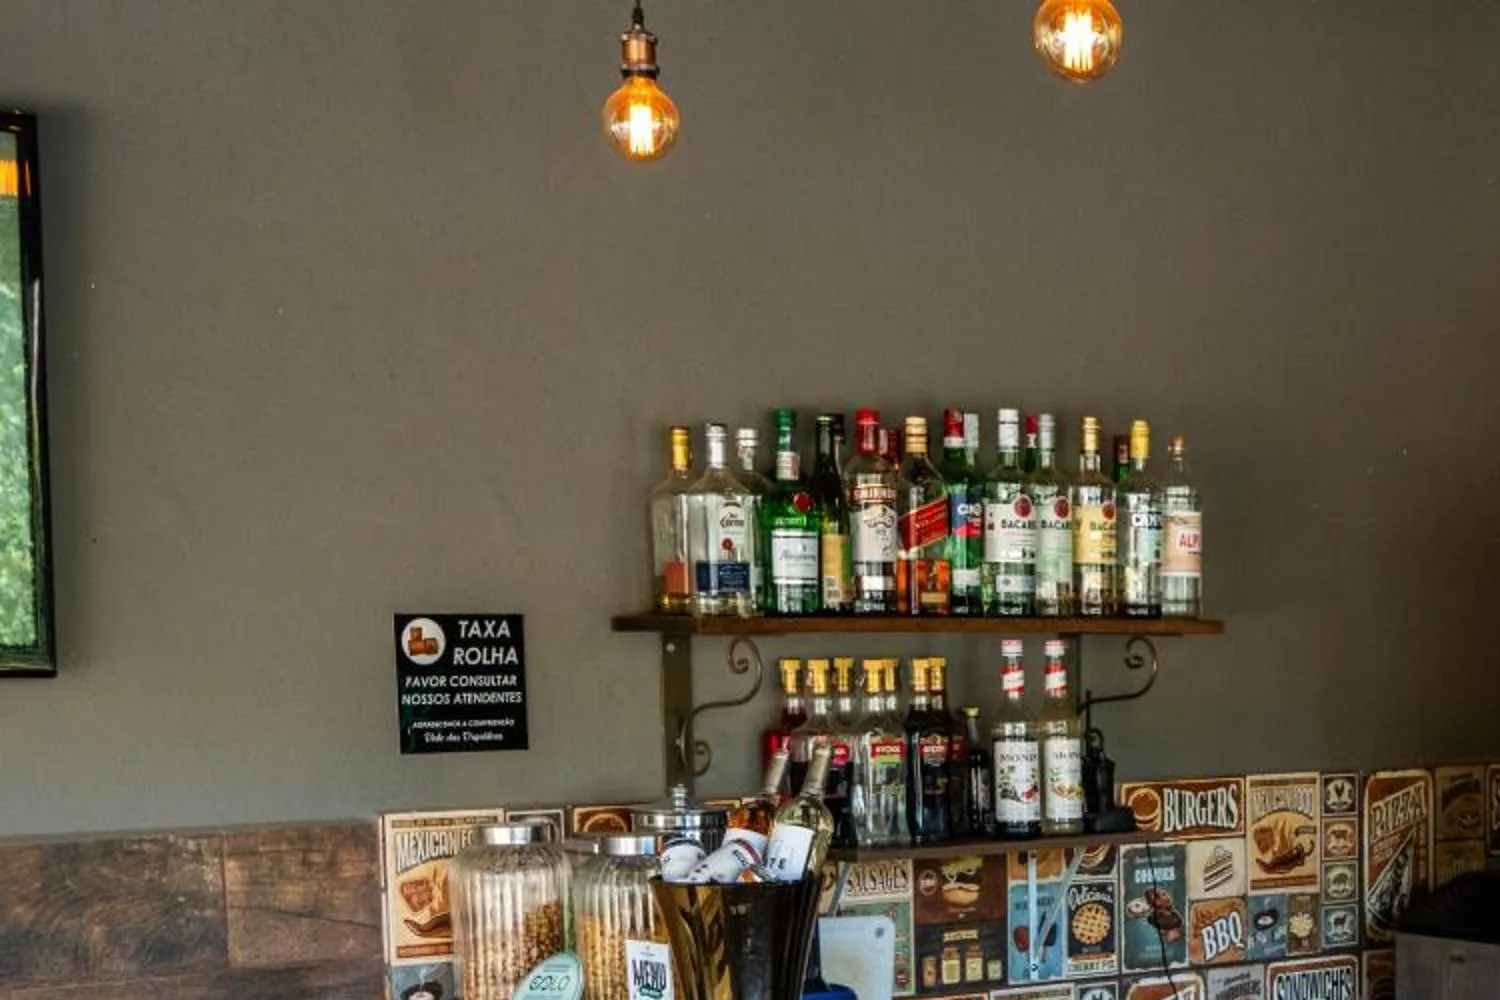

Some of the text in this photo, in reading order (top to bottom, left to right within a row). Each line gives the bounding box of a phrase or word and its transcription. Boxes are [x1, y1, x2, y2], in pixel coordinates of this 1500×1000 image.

[457, 620, 512, 639] TAXA
[453, 646, 519, 665] ROLHA
[404, 675, 448, 688] FAVOR
[449, 675, 518, 688] CONSULTAR
[401, 693, 451, 705] NOSSOS
[452, 691, 524, 705] ATENDENTES
[1163, 784, 1239, 833] BURGERS
[395, 831, 457, 875] MEXICAN
[1201, 911, 1245, 960] BBQ
[631, 959, 668, 991] MENU
